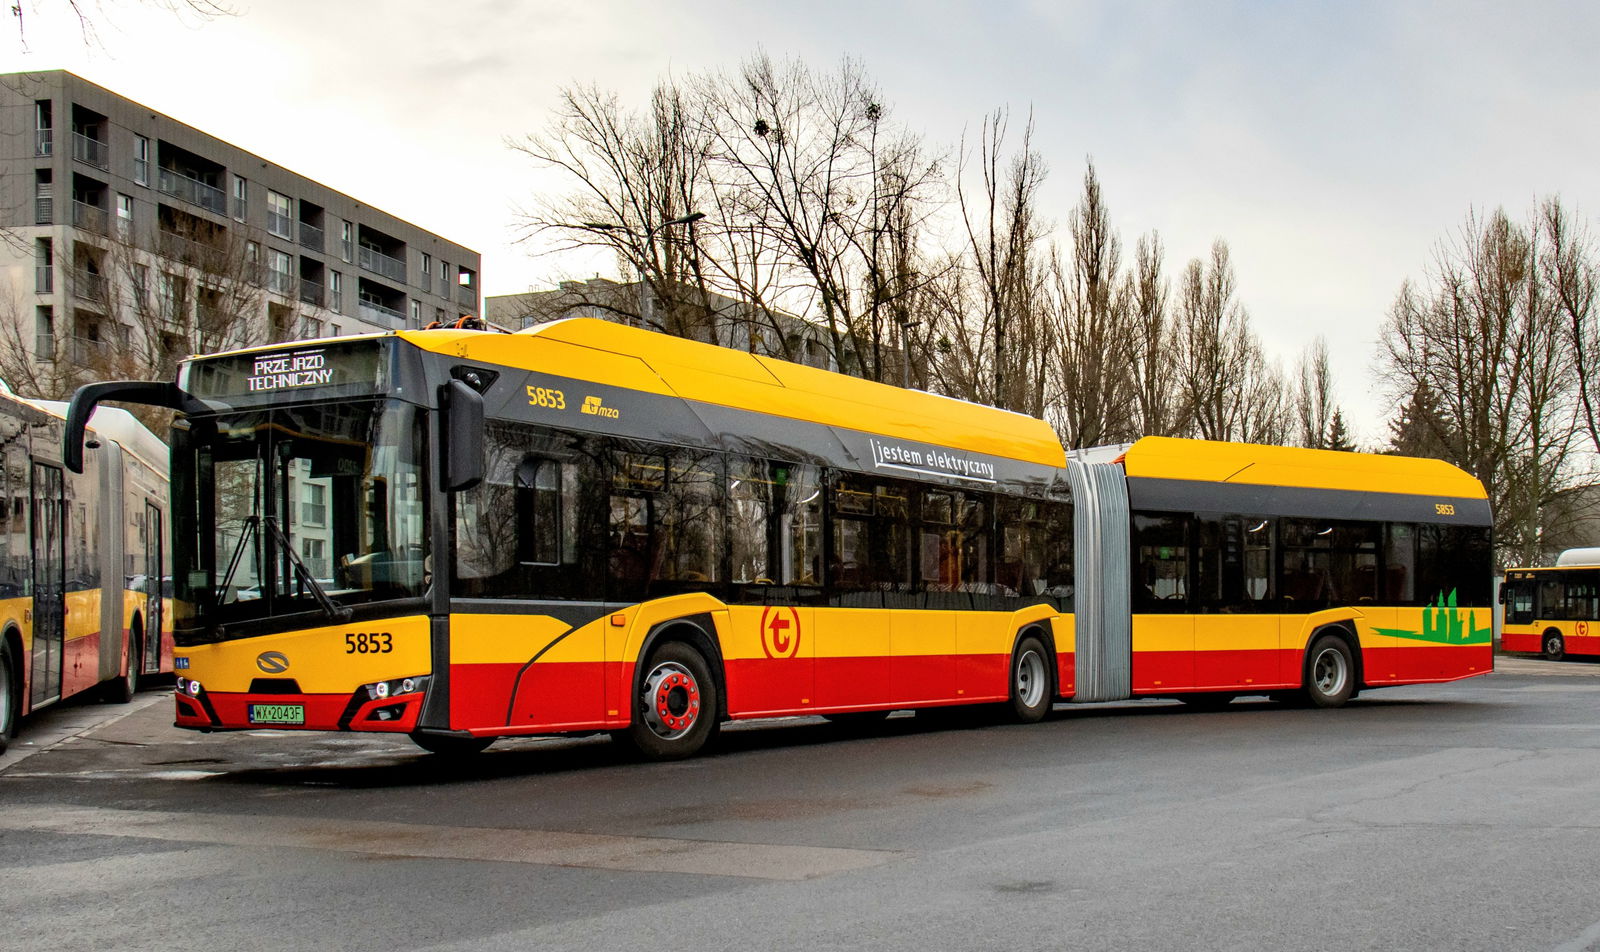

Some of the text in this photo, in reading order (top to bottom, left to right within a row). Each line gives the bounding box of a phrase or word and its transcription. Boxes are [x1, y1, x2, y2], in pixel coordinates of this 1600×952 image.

[254, 354, 325, 376] PRZEJAZD
[247, 368, 333, 391] TECHNICZNY
[526, 384, 566, 410] 5853
[597, 406, 620, 419] mza
[876, 440, 994, 479] jestem elektryczny
[1435, 503, 1455, 515] 5853
[345, 632, 393, 654] 5853
[255, 706, 301, 720] WX 2043F
